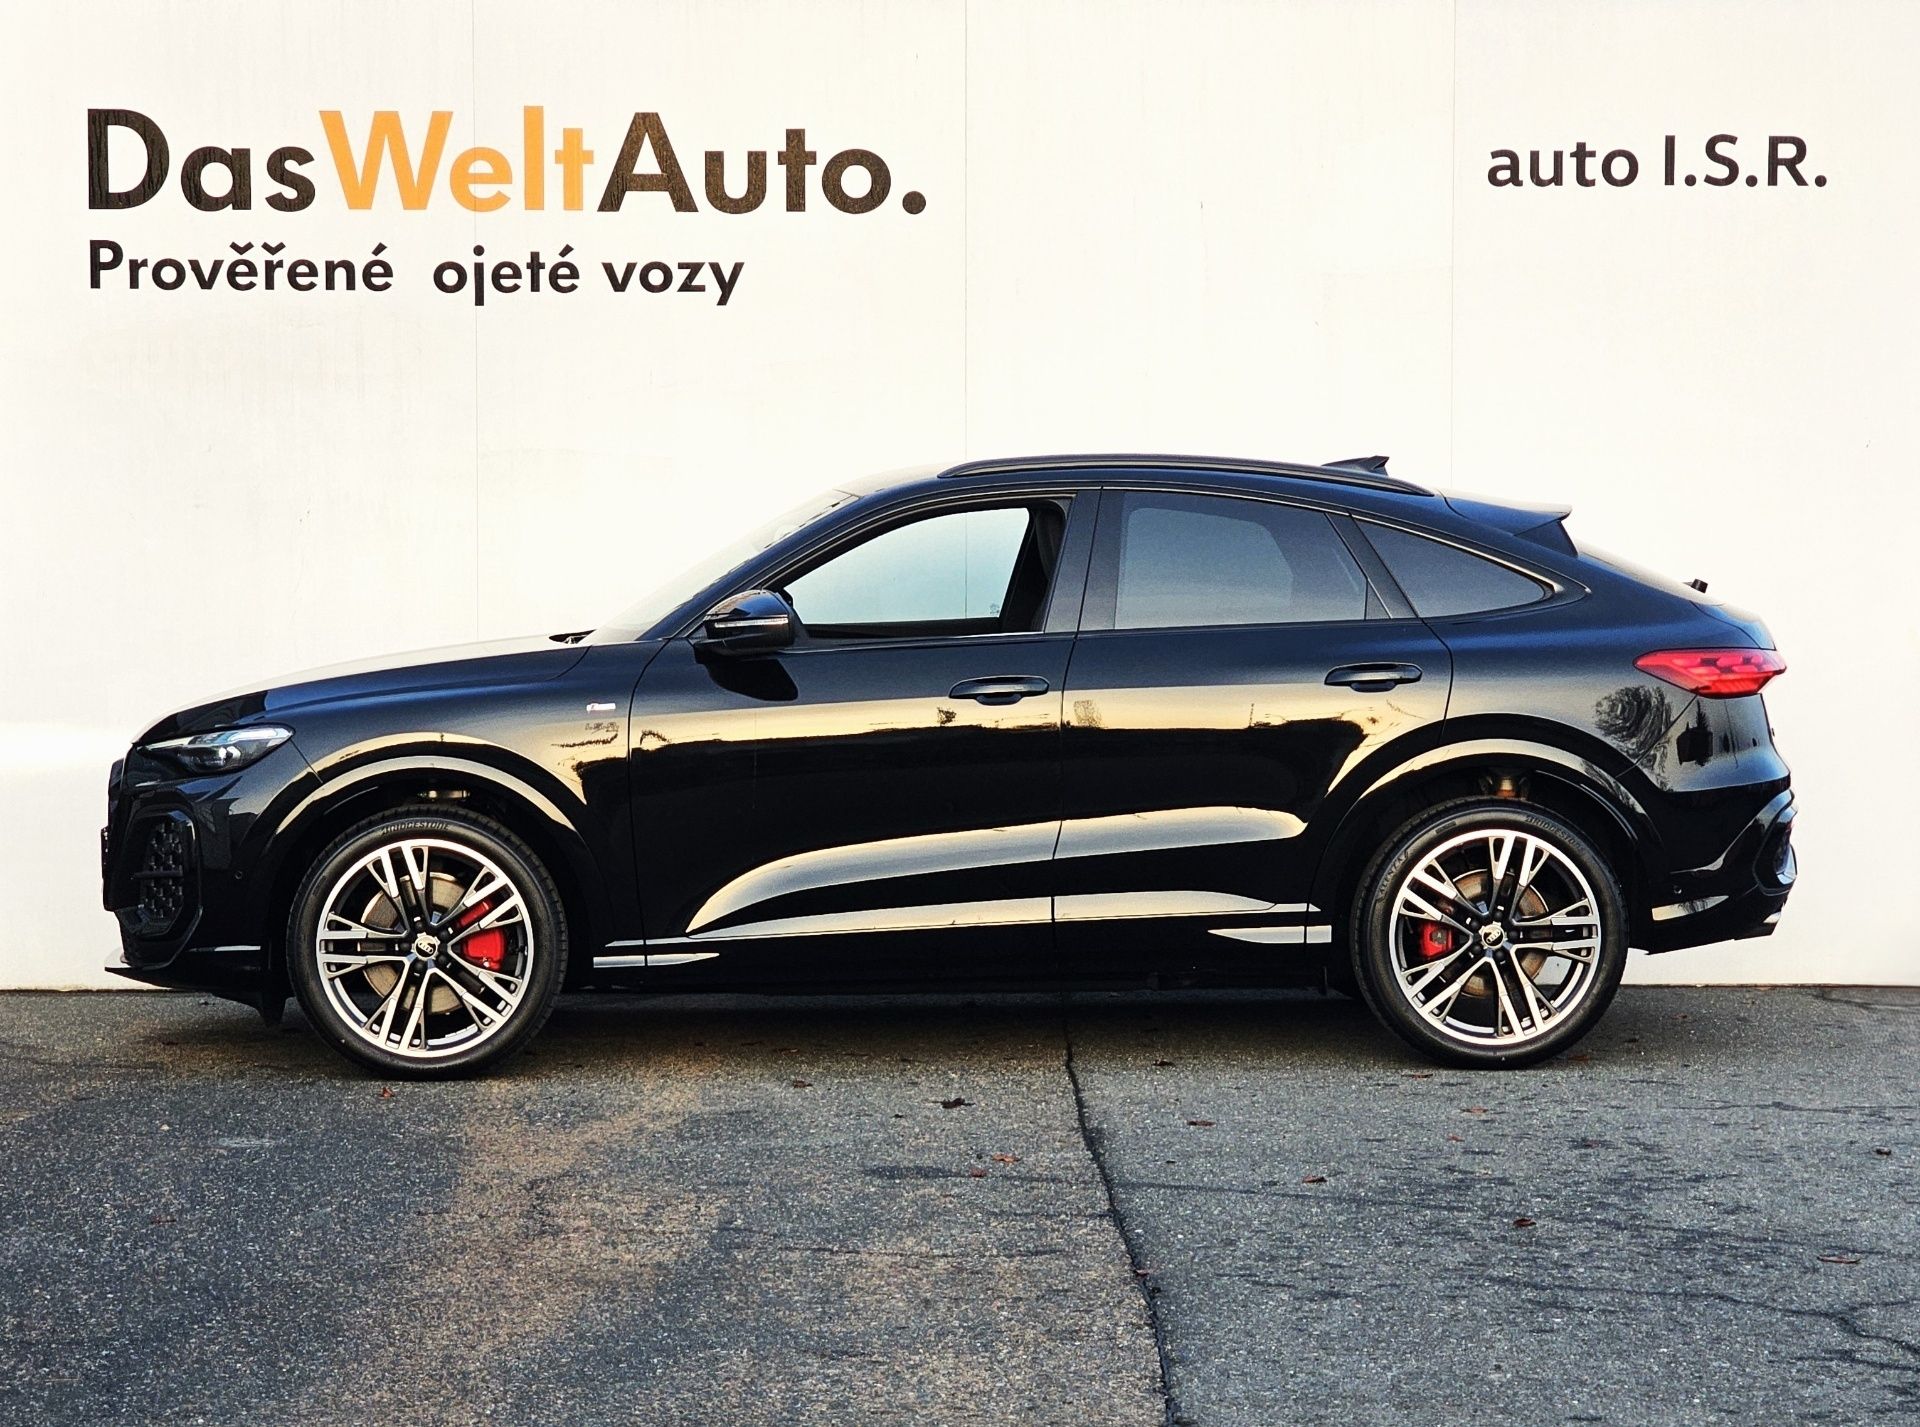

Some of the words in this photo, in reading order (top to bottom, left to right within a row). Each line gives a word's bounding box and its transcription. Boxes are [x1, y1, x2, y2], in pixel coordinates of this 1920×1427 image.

[1488, 141, 1639, 187] auto
[1664, 134, 1828, 187] I.S.R.
[90, 240, 394, 291] Prověřené
[434, 243, 580, 306] ojeté
[602, 261, 745, 306] vozy
